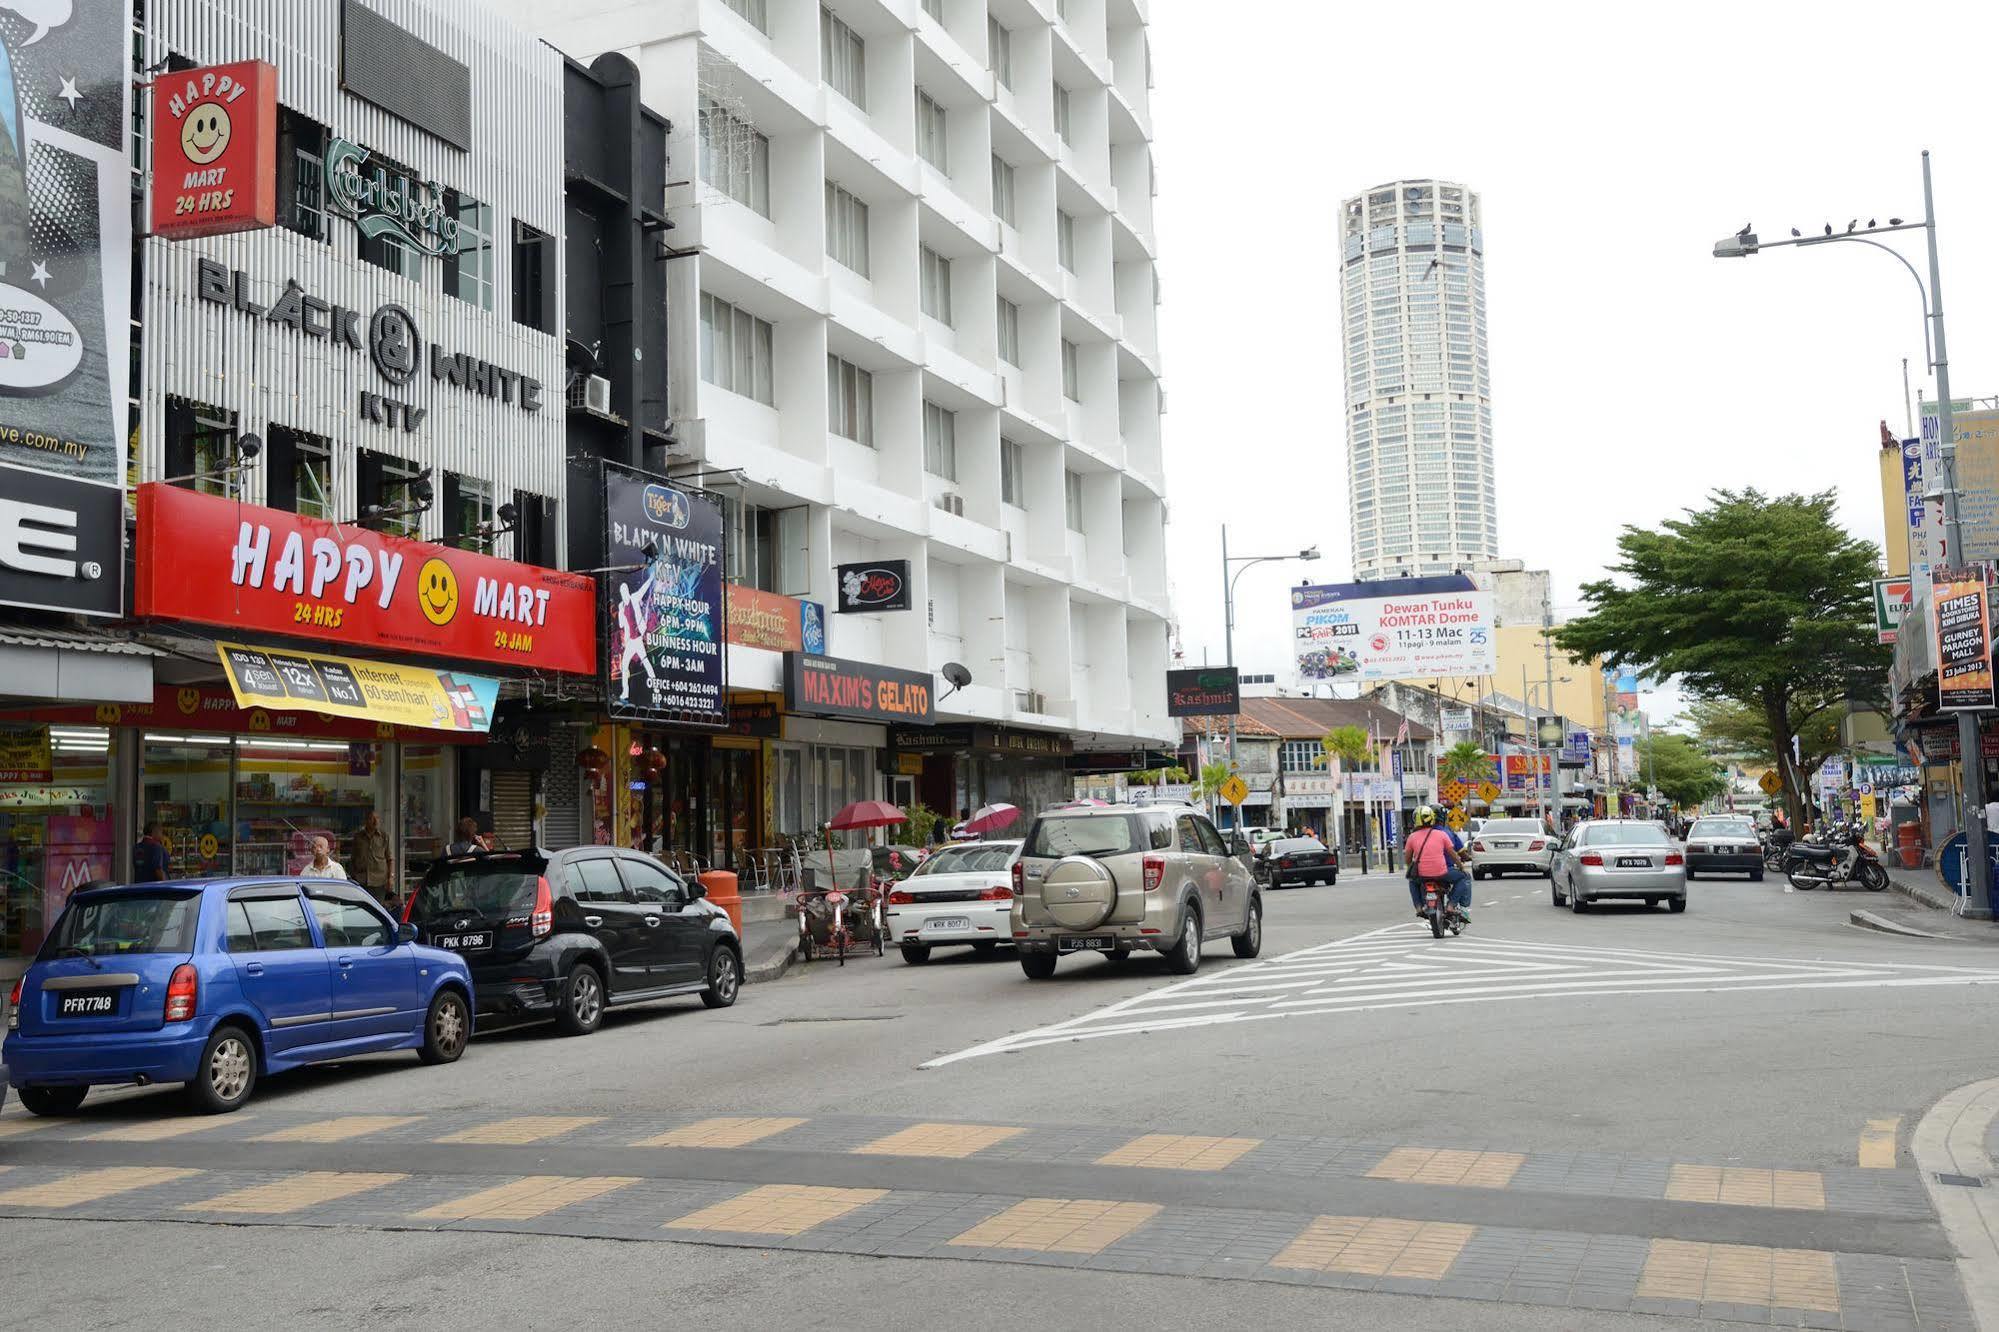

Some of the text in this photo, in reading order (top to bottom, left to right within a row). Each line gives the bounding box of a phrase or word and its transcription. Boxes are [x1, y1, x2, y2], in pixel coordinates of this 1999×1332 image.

[168, 72, 247, 119] HAPPY
[184, 167, 226, 190] MART
[175, 189, 234, 215] 24 HRS
[327, 137, 460, 255] Carlsberg
[199, 257, 544, 412] BLACK & WHITE
[360, 390, 428, 433] KTV
[647, 493, 672, 517] Tiger
[662, 534, 671, 556] N
[675, 537, 717, 565] WHITE
[231, 521, 403, 610] HAPPY
[655, 560, 681, 584] KTV
[473, 576, 551, 627] MART
[653, 593, 710, 615] HAPPY HOUR
[1383, 599, 1473, 615] Dewan Tunku
[1889, 603, 1913, 613] ELEV
[1940, 594, 1978, 613] TIMES
[294, 603, 344, 629] 24 HRS
[1306, 613, 1350, 625] PIKOM
[1379, 612, 1479, 628] KOMTAR Dome
[1941, 605, 1979, 619] BOOKSTORES
[1942, 611, 1980, 628] KINI DIBUKA
[660, 615, 681, 630] 6PM
[685, 618, 704, 633] 9PM
[1297, 628, 1312, 638] PC
[1334, 625, 1357, 635] 2011
[494, 630, 533, 653] 24 JAM
[1397, 626, 1463, 640] 11-13 Mac
[1469, 632, 1487, 645] 25
[1944, 627, 1979, 644] GURNEY
[646, 632, 717, 655] BUINNESS HOUR
[1398, 640, 1424, 651] 11pagi
[1436, 637, 1462, 647] malam
[1942, 636, 1983, 653] PARAGON
[1951, 647, 1974, 660] MALL
[660, 655, 680, 669] 6PM
[686, 658, 705, 673] 3AM
[1967, 661, 1983, 672] 2013
[245, 669, 275, 688] 4 sen
[282, 667, 316, 688] 12x
[354, 665, 403, 686] Internet
[331, 684, 359, 701] No.1
[364, 684, 430, 706] 60 sen/hari
[671, 681, 688, 692] +604
[688, 681, 701, 693] 262
[702, 682, 719, 696] 4494
[803, 670, 928, 717] MAXIM'S GELATO
[203, 697, 238, 711] HAPPY
[652, 693, 715, 709] HP +6016 423 3221
[1173, 691, 1233, 707] Kashmir
[276, 716, 297, 726] MART
[896, 733, 945, 748] Kashmir
[0, 770, 18, 780] APPY
[443, 934, 484, 948] PKK 8796
[1071, 938, 1084, 948] PJS
